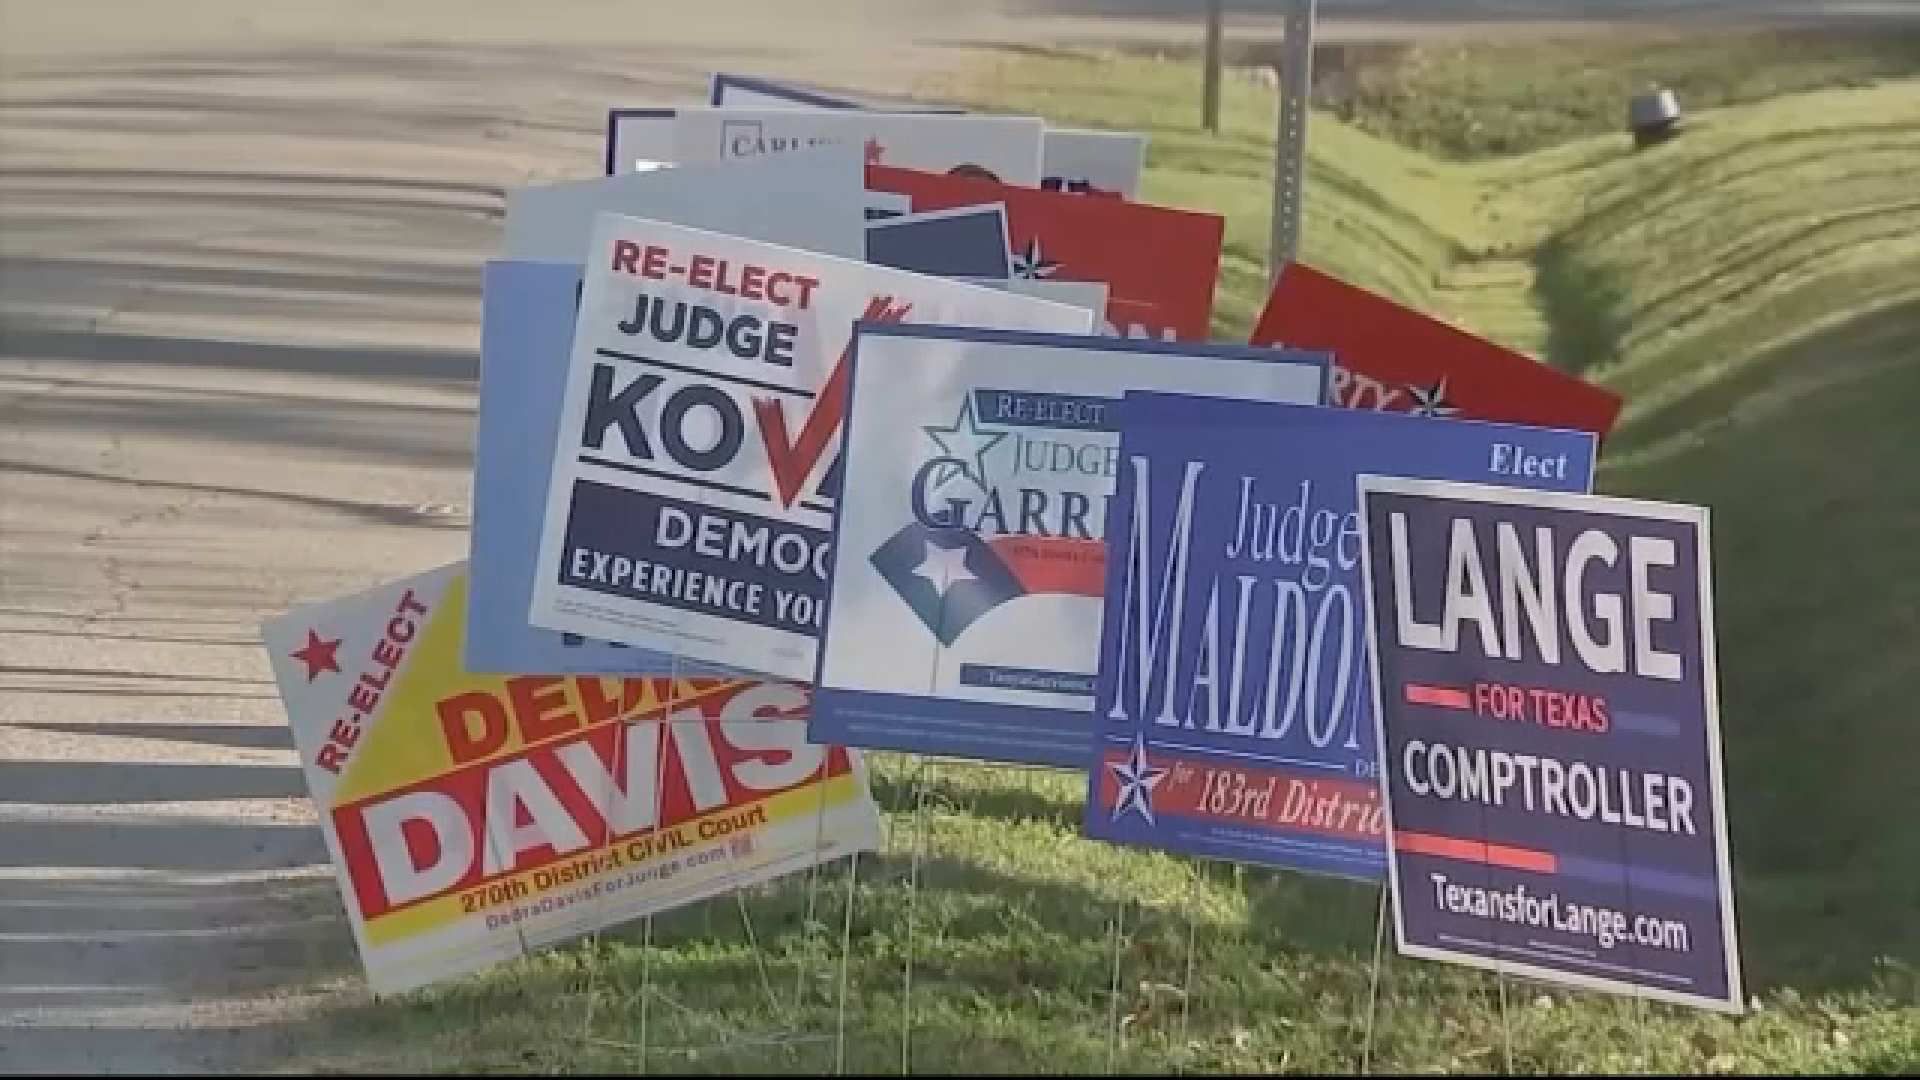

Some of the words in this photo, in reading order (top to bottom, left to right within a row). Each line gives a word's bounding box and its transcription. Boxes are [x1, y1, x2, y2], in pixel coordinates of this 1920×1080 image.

[612, 239, 819, 309] RE-ELECT
[618, 293, 798, 367] JUDGE
[1013, 434, 1117, 477] JUDGE
[1488, 443, 1567, 480] Elect
[1227, 476, 1361, 590] Judge
[572, 548, 763, 613] EXPERIENCE
[1389, 512, 1684, 681] LANGE
[316, 588, 426, 776] RE-ELECT
[1474, 683, 1527, 720] FOR
[1529, 689, 1609, 733] TEXAS
[362, 683, 827, 906] DAVIS
[1195, 770, 1277, 819] 183rd
[1403, 740, 1696, 835] COMPTROLLER
[461, 878, 528, 913] 270th
[532, 849, 623, 891] District
[698, 803, 769, 840] Court
[1431, 873, 1690, 951] TexansforLange.com
